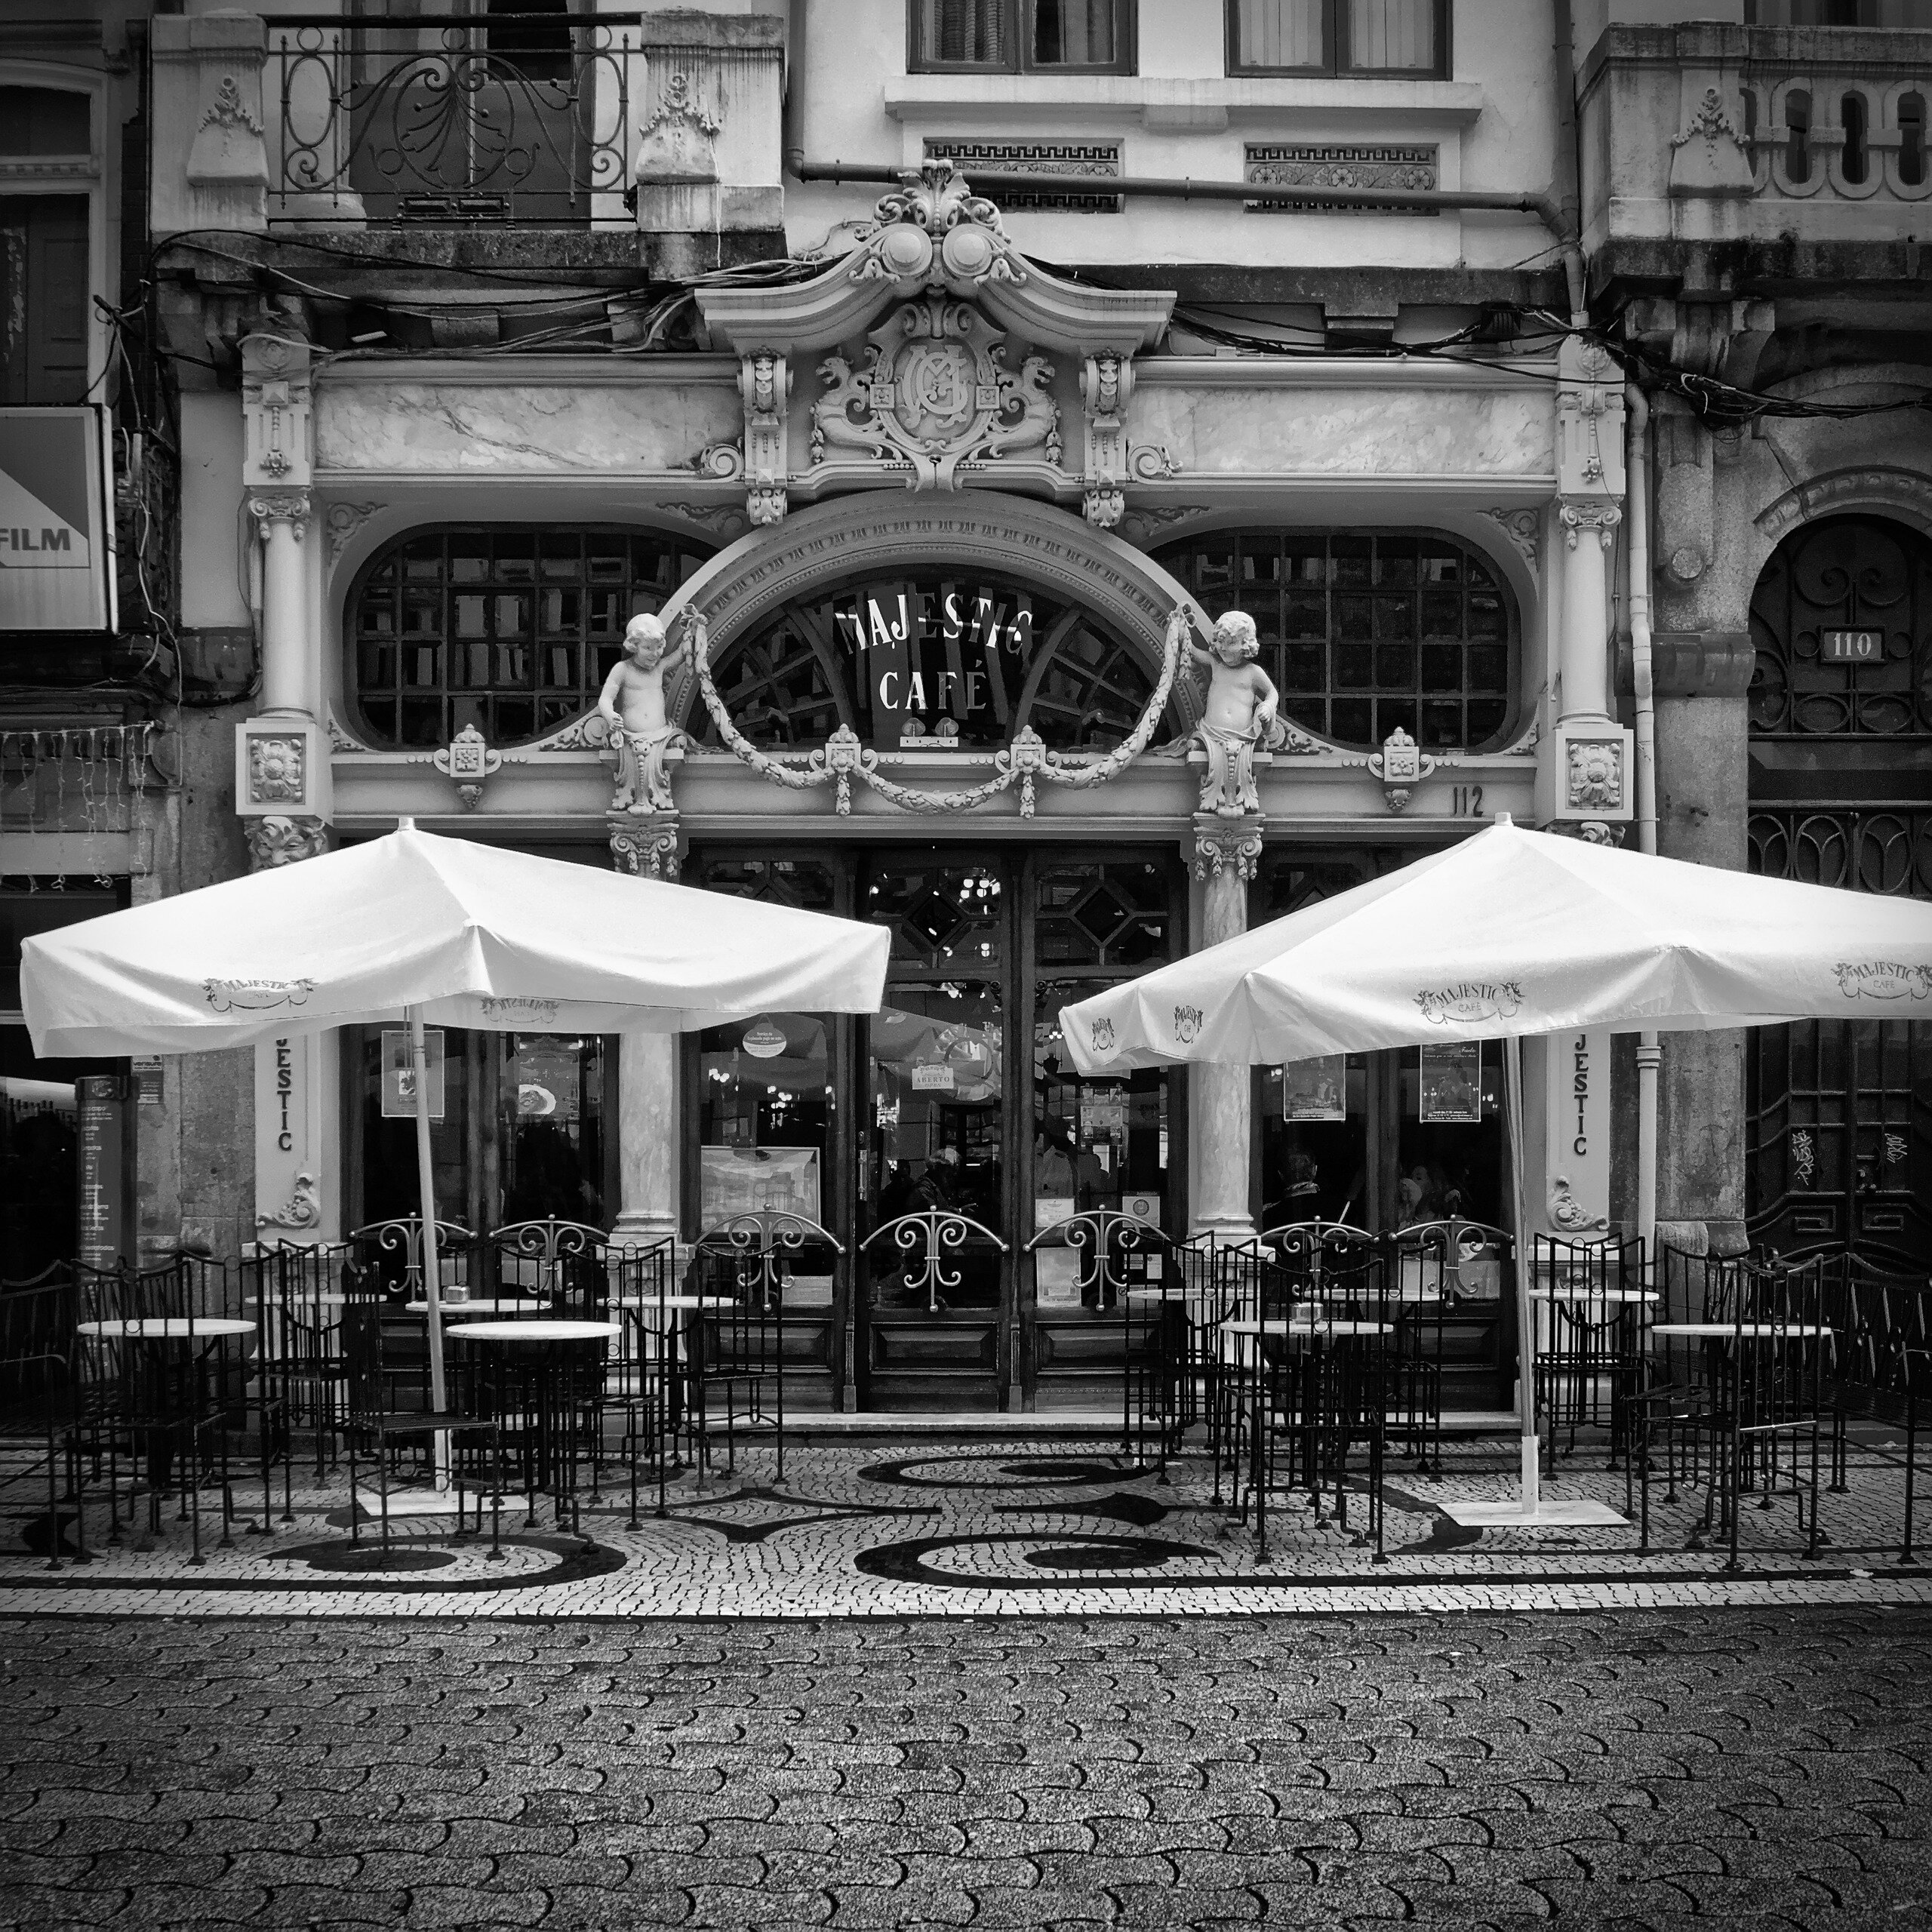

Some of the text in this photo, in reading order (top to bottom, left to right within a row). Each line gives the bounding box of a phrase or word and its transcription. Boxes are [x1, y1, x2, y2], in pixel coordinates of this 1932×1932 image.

[835, 592, 1033, 655] MAJESTIC
[1834, 632, 1872, 656] 110
[879, 660, 986, 709] CAFÉ
[1454, 786, 1483, 817] 112
[1853, 961, 1915, 982] MAJESTIC
[223, 980, 291, 992] MAJESTIC
[1434, 983, 1500, 1008] MAJESTIC
